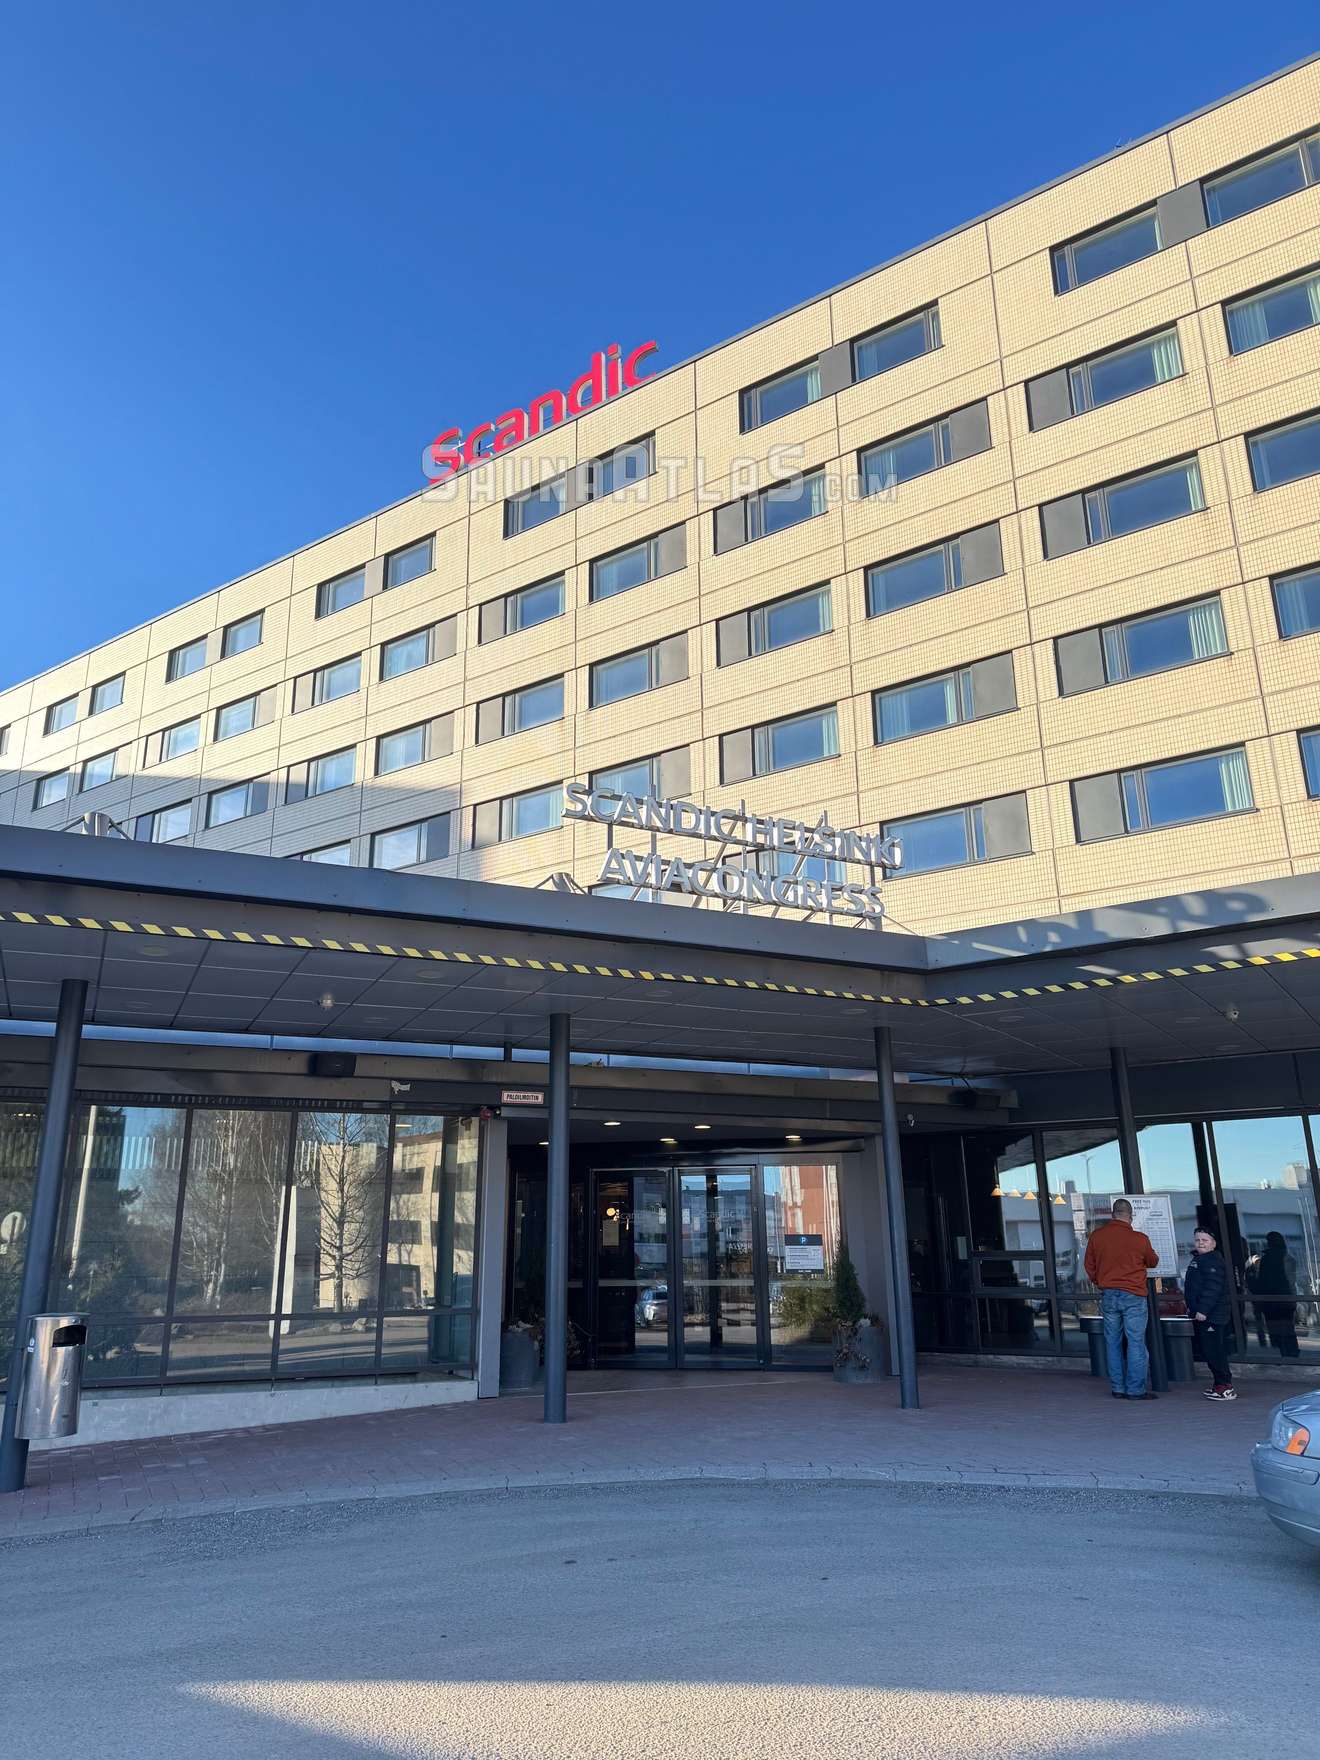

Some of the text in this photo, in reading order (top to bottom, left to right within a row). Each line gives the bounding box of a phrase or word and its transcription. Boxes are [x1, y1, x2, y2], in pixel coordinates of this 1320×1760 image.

[430, 340, 658, 484] Scandic
[561, 782, 903, 869] SCANDIC HELSINKI
[598, 847, 886, 918] AVIACONGRESS
